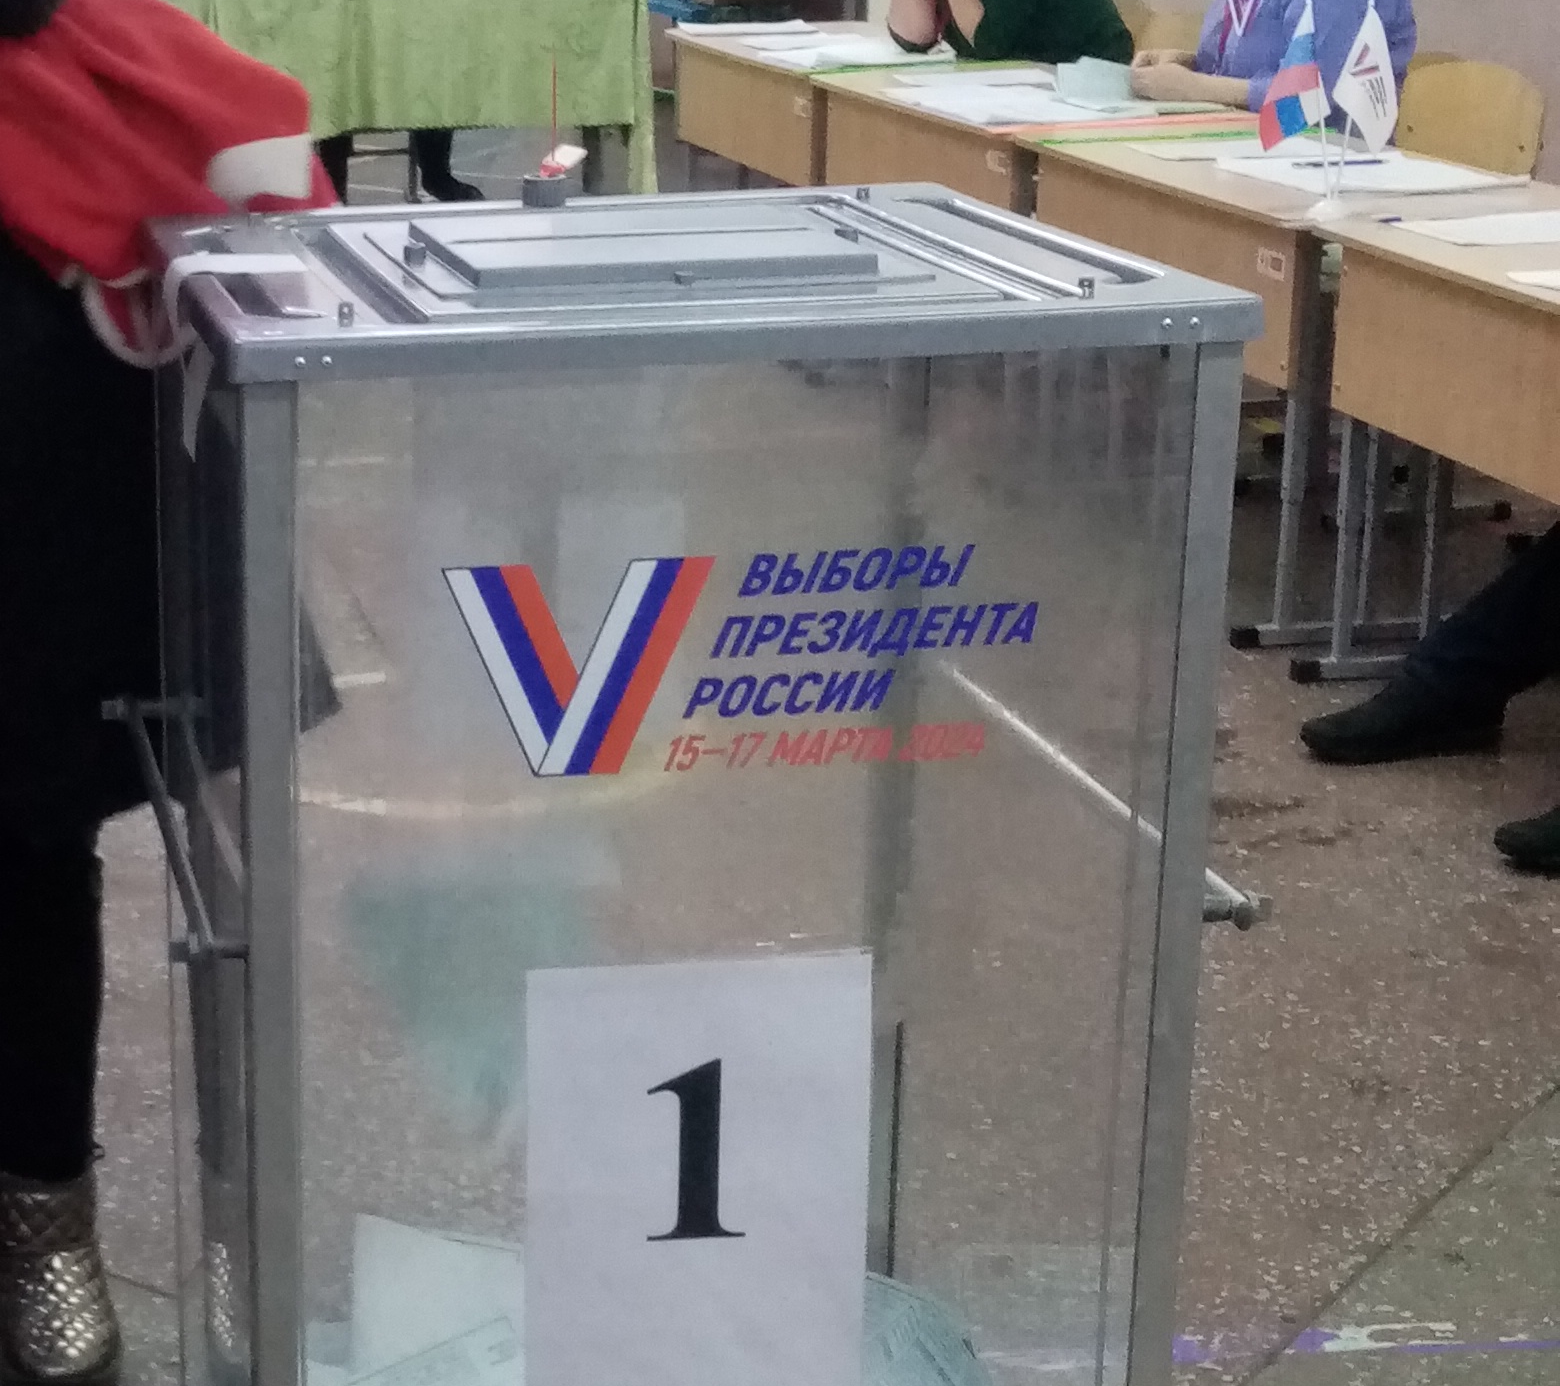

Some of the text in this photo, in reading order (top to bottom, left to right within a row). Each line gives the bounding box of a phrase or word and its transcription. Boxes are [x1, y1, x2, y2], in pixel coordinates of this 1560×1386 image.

[738, 544, 976, 598] ВЫБОРЫ
[709, 601, 1039, 659] ПРЕЗИДЕНТА
[682, 669, 895, 719] РОССИИ
[769, 724, 893, 766] МАРТА
[646, 1058, 746, 1242] 1
